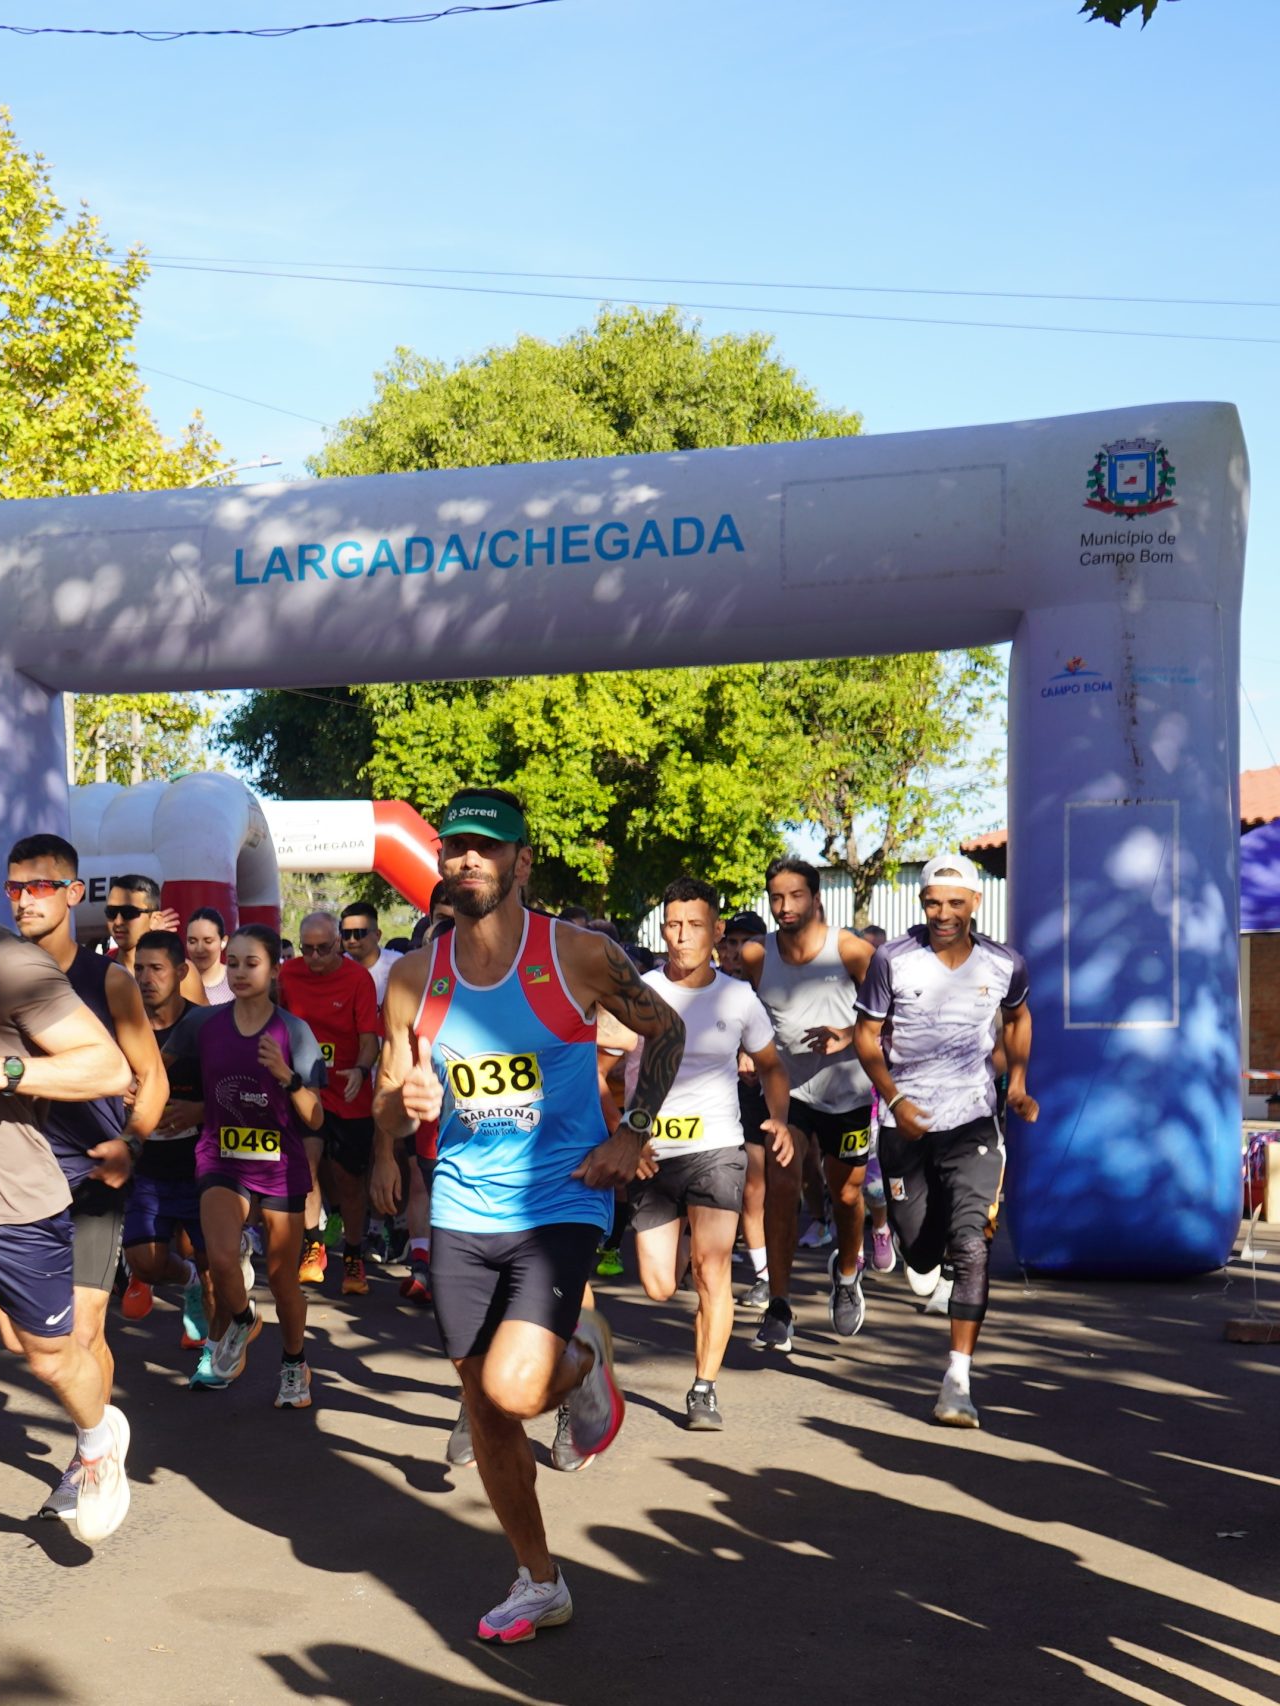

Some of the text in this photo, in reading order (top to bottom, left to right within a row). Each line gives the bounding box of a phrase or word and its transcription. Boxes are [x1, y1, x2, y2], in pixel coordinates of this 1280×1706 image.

[1080, 530, 1176, 547] Município de
[235, 514, 745, 585] LARGADA/CHEGADA
[1080, 549, 1173, 567] Campo Bom
[1041, 682, 1113, 698] CAMPO BOM
[458, 807, 498, 818] Sicredi
[305, 840, 365, 852] CHEGADA
[452, 1056, 536, 1097] 038
[461, 1108, 535, 1125] MARATONA
[480, 1120, 515, 1128] CLUBE
[223, 1128, 279, 1152] 046
